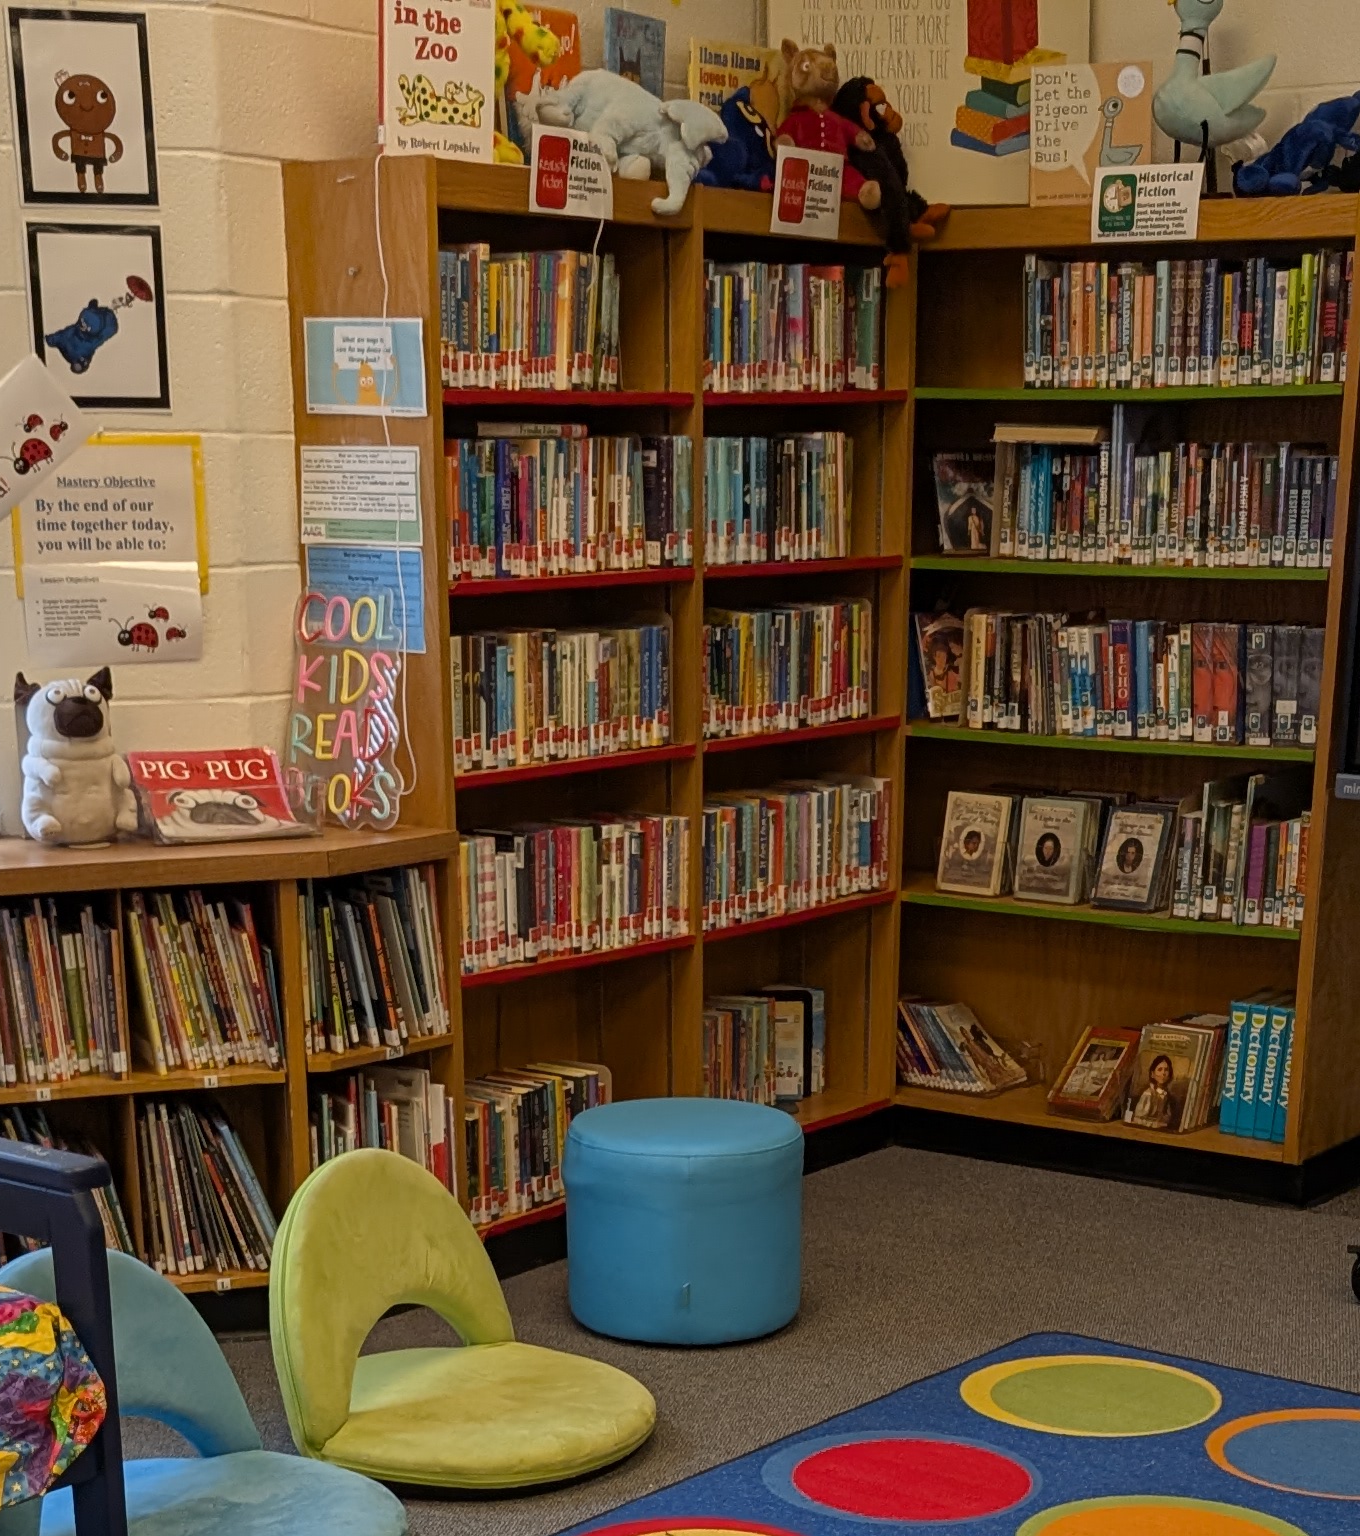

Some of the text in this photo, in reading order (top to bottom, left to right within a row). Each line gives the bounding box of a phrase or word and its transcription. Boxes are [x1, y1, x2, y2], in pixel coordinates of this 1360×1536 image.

[394, 1, 461, 35] in the
[800, 14, 825, 45] WILL
[888, 14, 909, 45] THE
[916, 14, 951, 45] MORE
[415, 37, 458, 62] Zoo
[843, 49, 868, 79] YOU
[929, 49, 951, 80] THE
[700, 67, 739, 88] loves to
[1035, 71, 1078, 86] Don't
[1035, 86, 1091, 102] Let the
[1035, 104, 1089, 118] Pigeon
[1035, 119, 1080, 133] Drive
[397, 135, 409, 149] by
[410, 137, 441, 150] Robert
[1036, 135, 1061, 147] the
[570, 155, 602, 172] Fiction
[1035, 150, 1069, 163] Bus!
[1139, 169, 1194, 184] Historical
[808, 179, 832, 192] Fiction
[1137, 185, 1176, 197] Fiction
[56, 475, 155, 488] Mastery Objective
[36, 499, 154, 514] By the end of our
[36, 518, 174, 535] time together today,
[38, 537, 166, 554] you will be able to:
[298, 592, 394, 643] COOL
[296, 650, 393, 704] KIDS
[1118, 653, 1128, 698] ECHO
[292, 707, 391, 763] READ
[138, 758, 269, 781] PIG PUG
[285, 766, 396, 820] BOOKS
[1222, 1011, 1247, 1102] Dictionary
[1240, 1013, 1267, 1105] Dictionary
[1258, 1015, 1287, 1107] Dictionary
[207, 1077, 216, 1087] L
[40, 1089, 48, 1099] L
